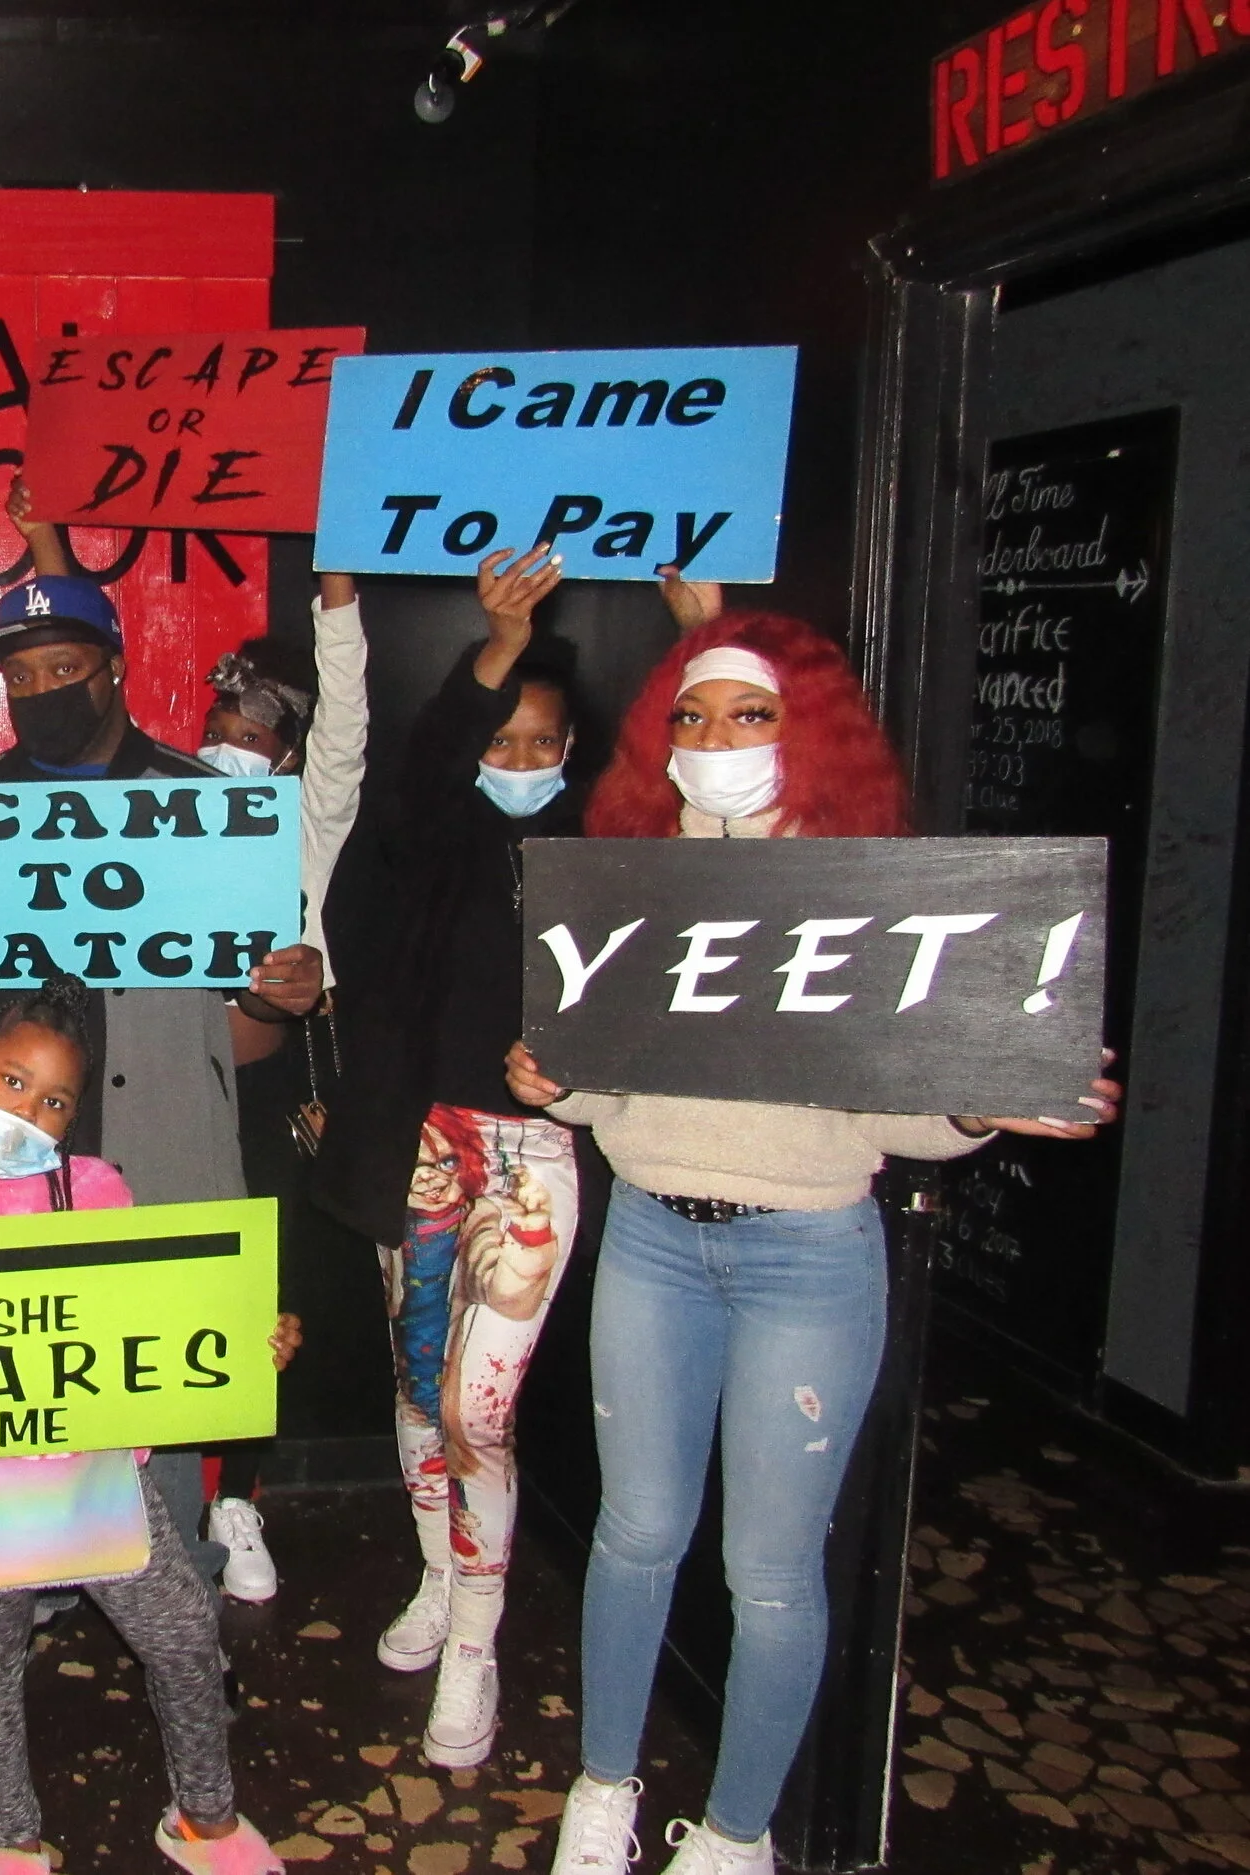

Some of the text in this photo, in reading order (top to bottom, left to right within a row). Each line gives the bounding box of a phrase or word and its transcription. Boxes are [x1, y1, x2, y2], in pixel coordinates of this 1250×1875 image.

[935, 0, 1250, 179] REST
[40, 341, 339, 397] ESCAPE
[147, 408, 205, 436] OR
[392, 366, 726, 430] I Came
[74, 444, 266, 512] DIE
[381, 495, 733, 576] To Pay
[977, 513, 1108, 576] derboard
[25, 584, 51, 616] LA
[972, 662, 1066, 714] vanced
[19, 861, 145, 911] TO
[0, 1407, 69, 1447] ME
